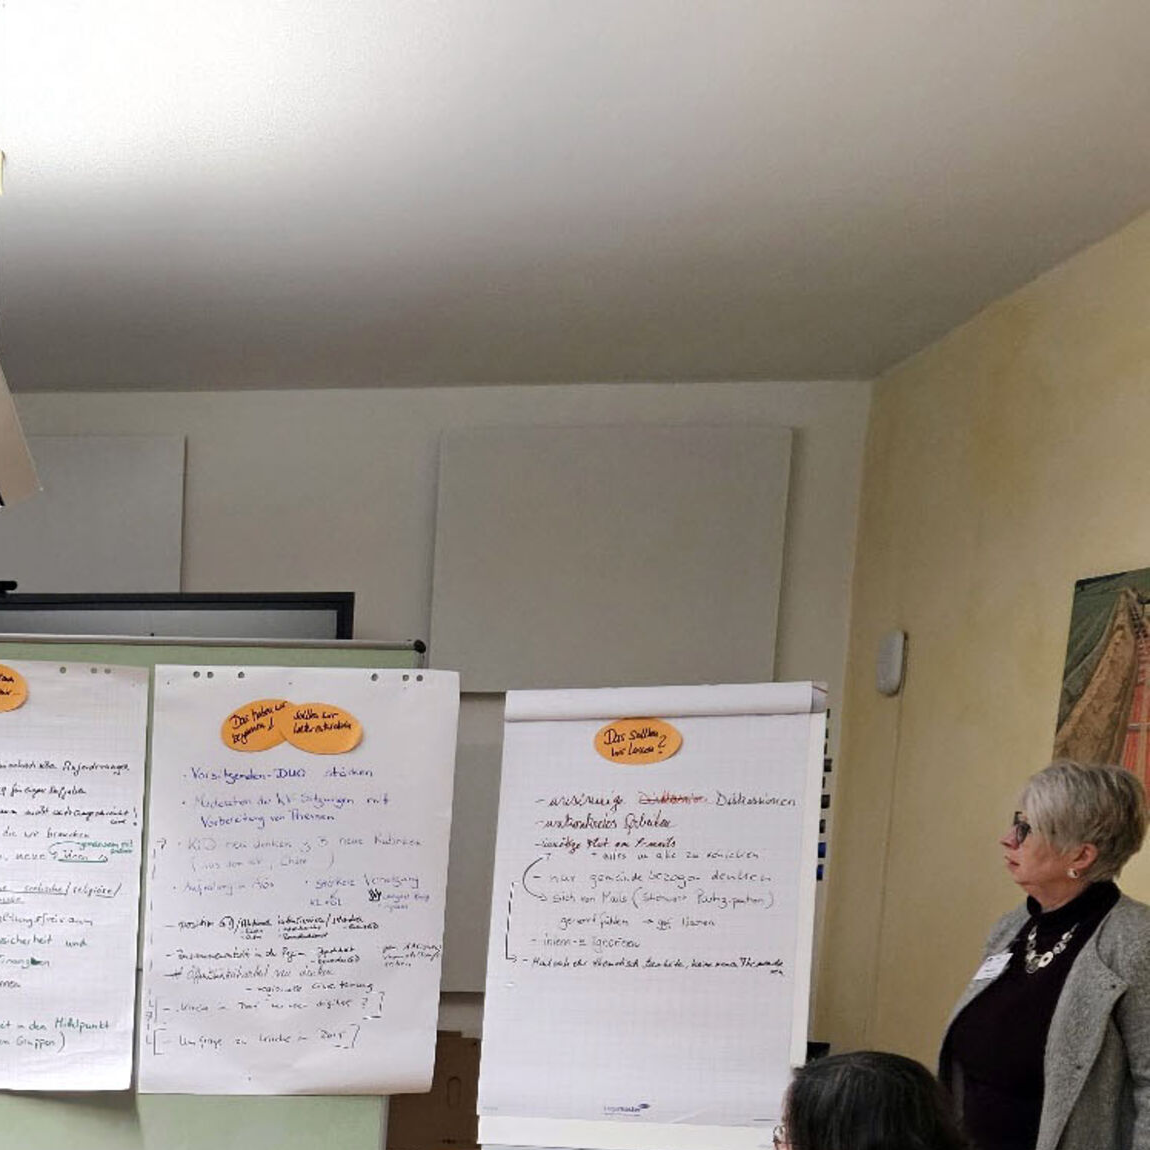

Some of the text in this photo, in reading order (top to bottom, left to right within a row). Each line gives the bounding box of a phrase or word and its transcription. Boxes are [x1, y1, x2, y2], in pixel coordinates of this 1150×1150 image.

[229, 714, 249, 729] Das
[603, 728, 625, 745] Das
[65, 939, 88, 948] und
